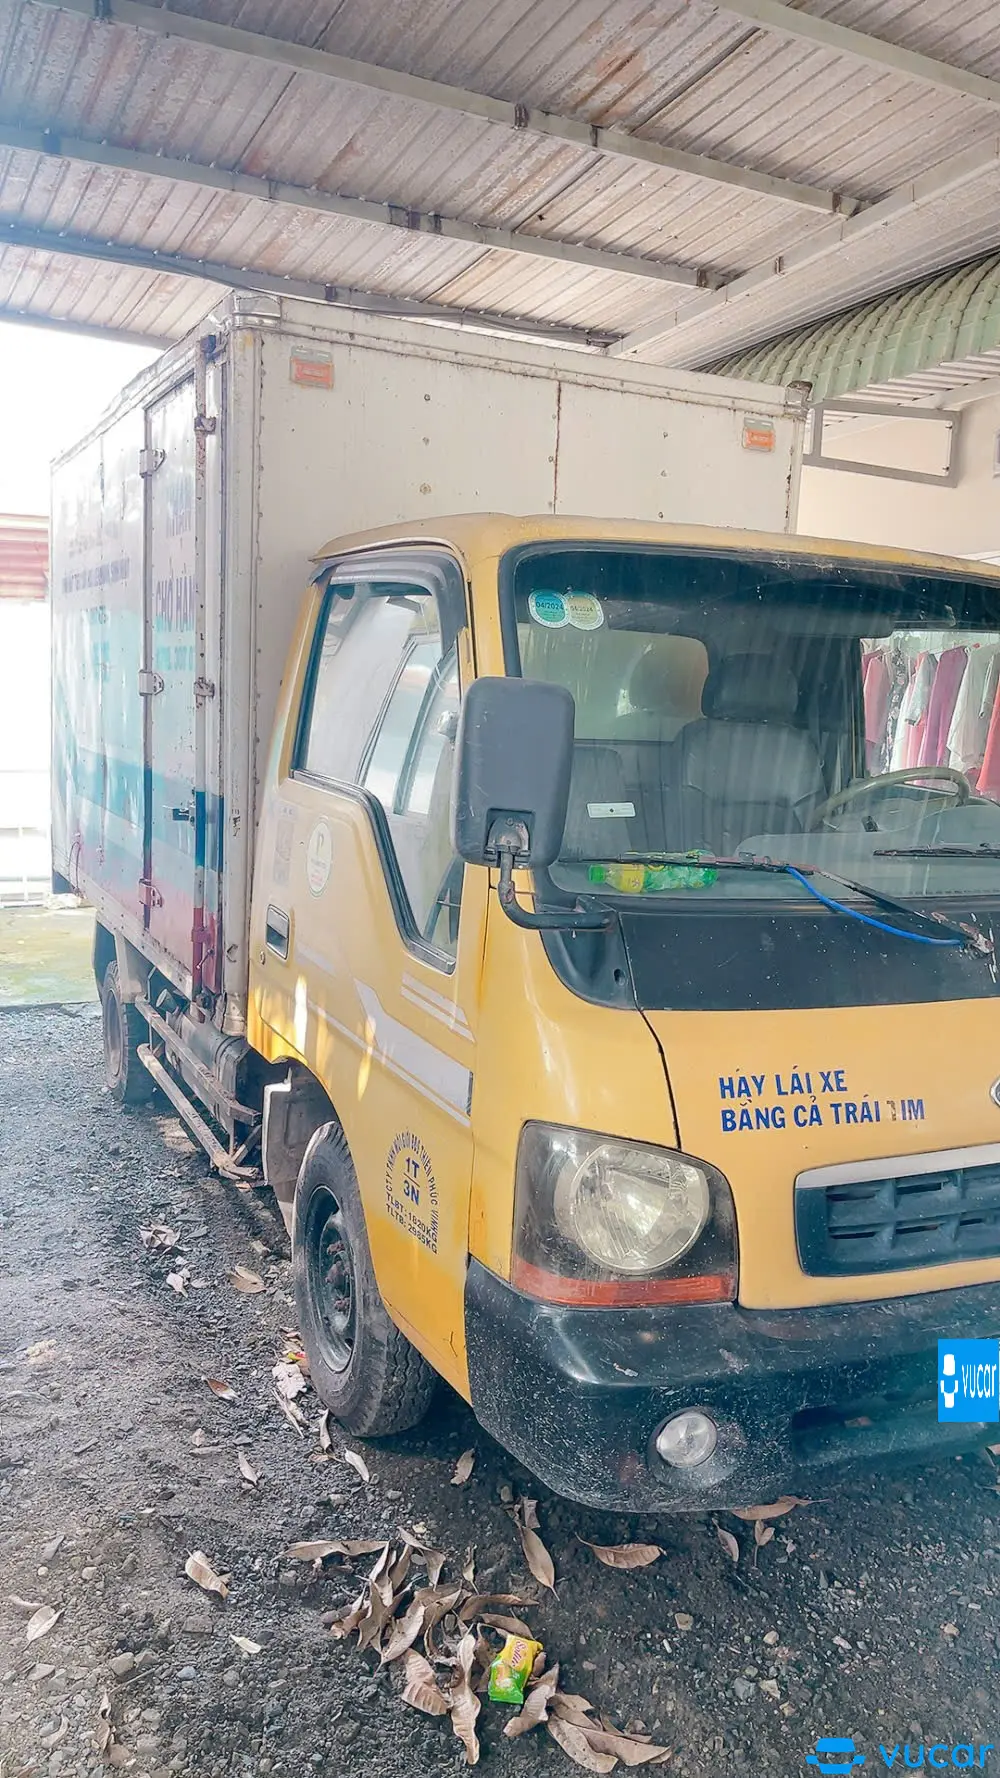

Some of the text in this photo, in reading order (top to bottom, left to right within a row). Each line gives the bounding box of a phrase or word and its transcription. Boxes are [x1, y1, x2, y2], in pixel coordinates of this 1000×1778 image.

[775, 1064, 813, 1096] LÁI
[818, 1069, 848, 1093] XE
[721, 1098, 786, 1132] BẰNG
[793, 1095, 823, 1127] CẢ
[830, 1094, 881, 1125] TRÁI
[405, 1156, 421, 1179] 1T
[403, 1179, 421, 1206] 3N
[427, 1176, 439, 1206] PHÚC
